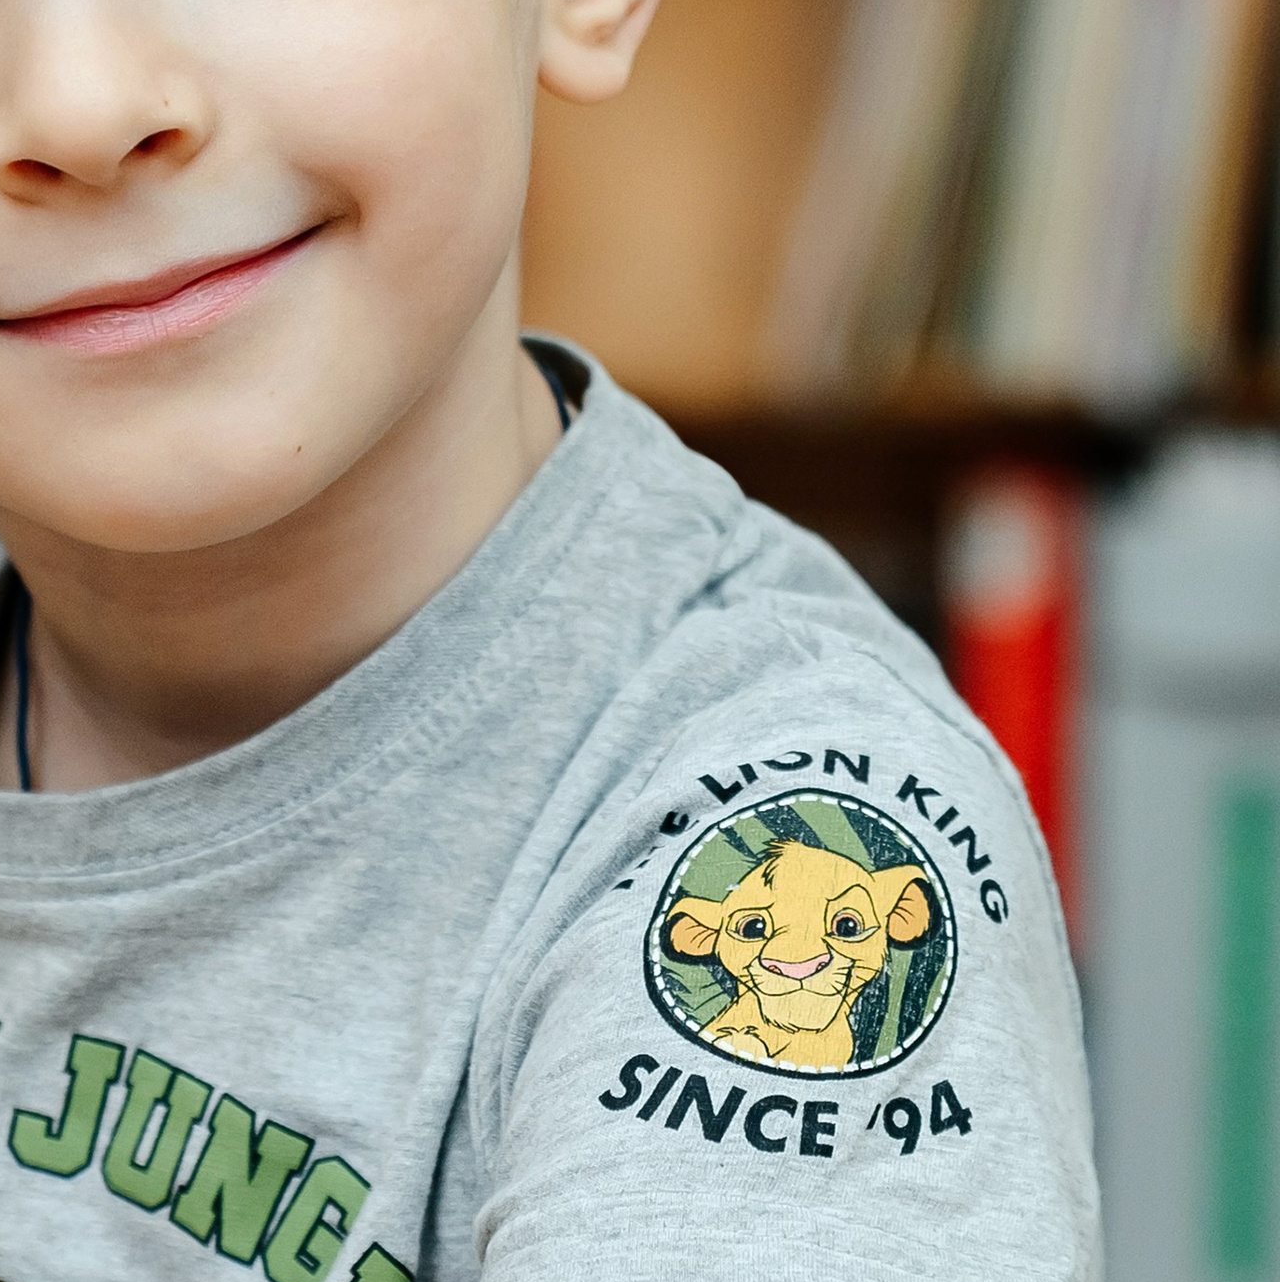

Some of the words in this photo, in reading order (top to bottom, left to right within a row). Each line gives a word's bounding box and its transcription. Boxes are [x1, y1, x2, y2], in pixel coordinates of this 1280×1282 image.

[895, 773, 1009, 924] KING
[598, 1053, 839, 1159] SINCE
[865, 1079, 973, 1157] '94
